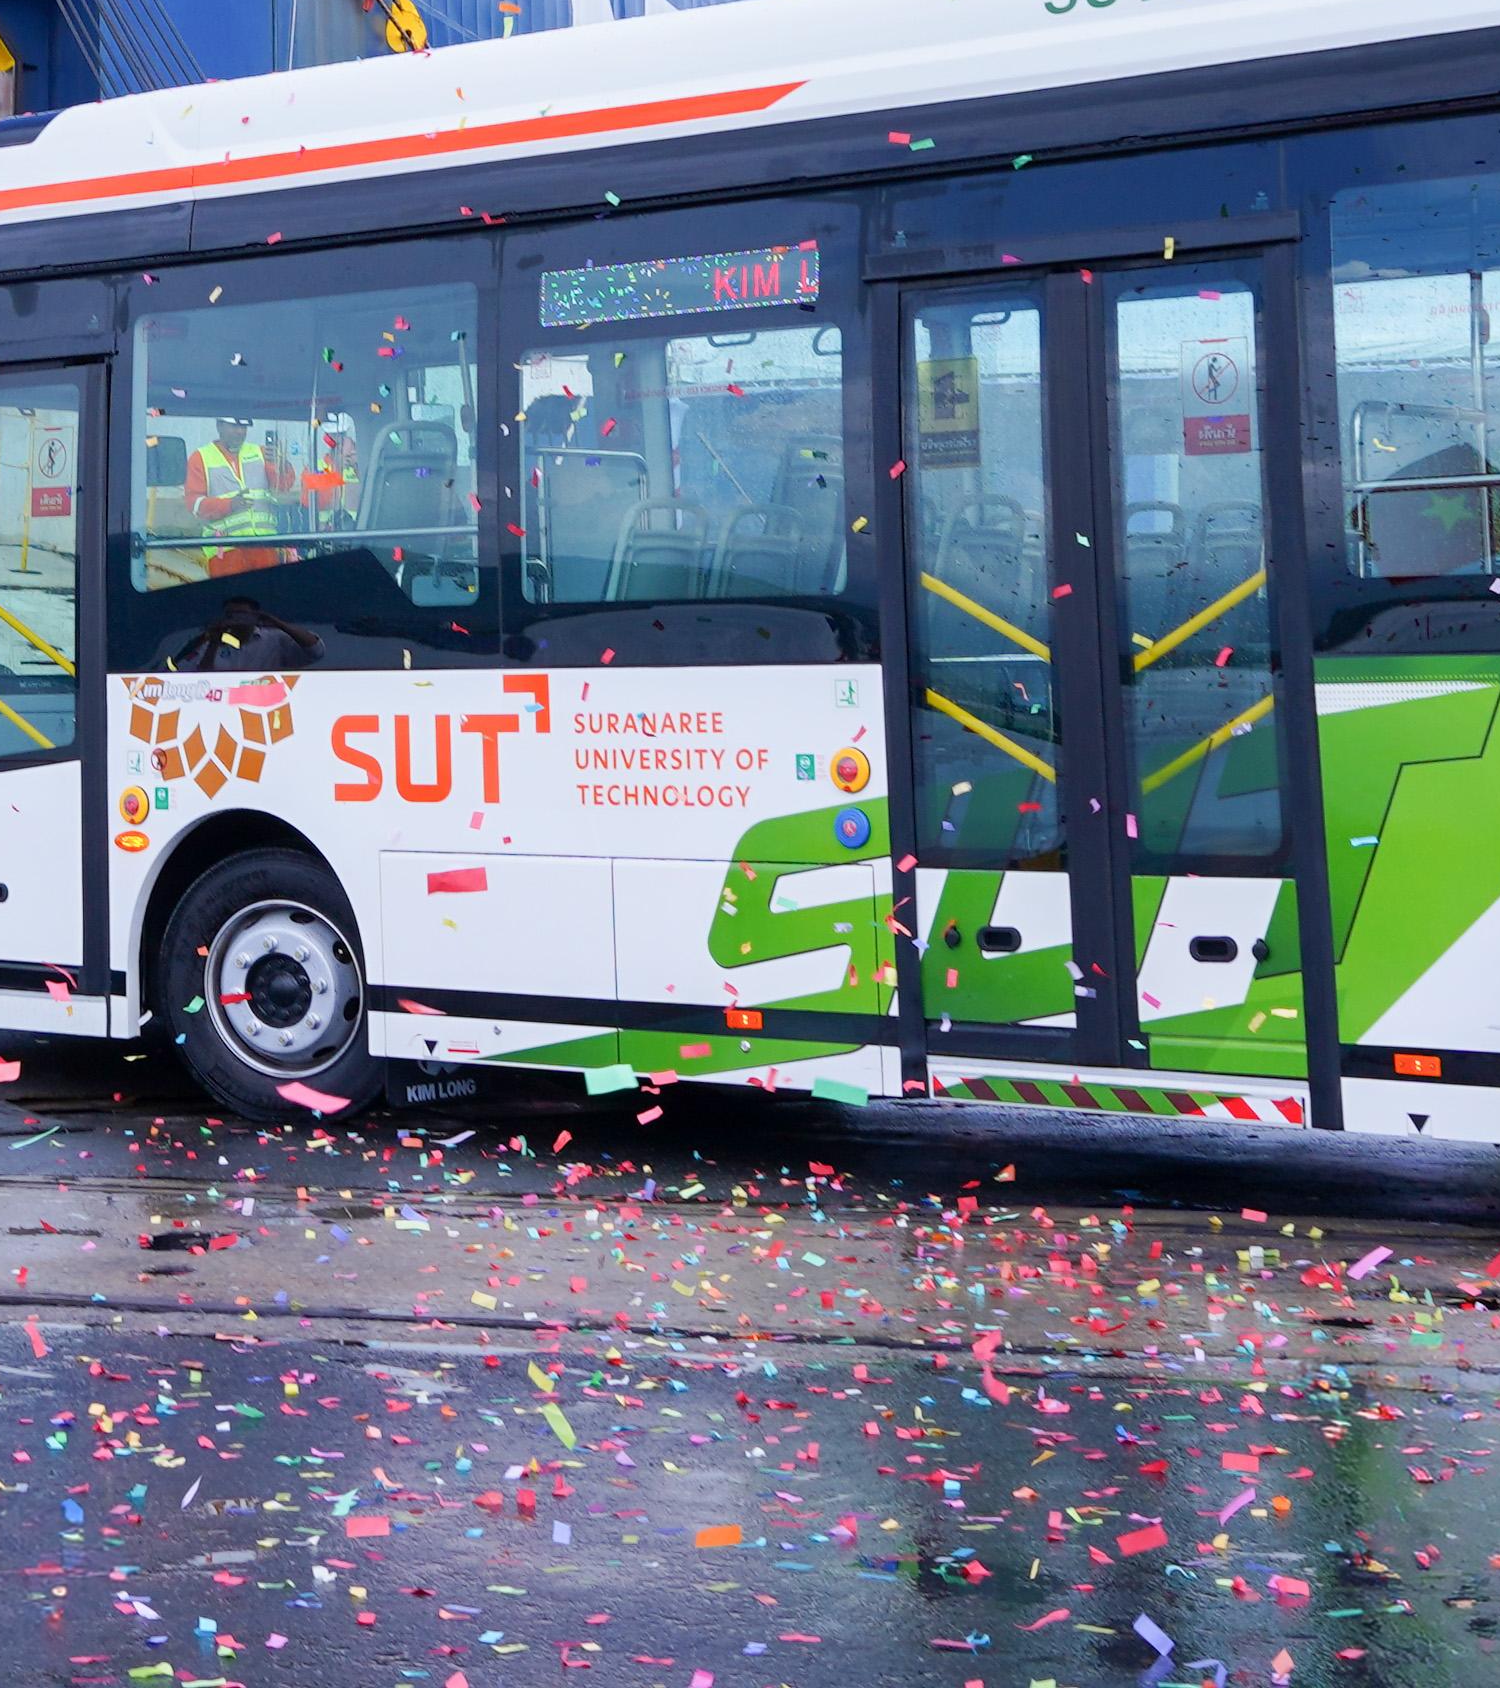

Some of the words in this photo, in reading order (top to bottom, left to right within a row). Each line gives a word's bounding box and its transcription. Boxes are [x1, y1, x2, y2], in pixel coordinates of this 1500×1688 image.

[713, 262, 782, 301] KIM
[573, 712, 724, 735] SURANAREE
[331, 714, 519, 804] SUT
[575, 749, 726, 770] UNIVERSITY
[736, 749, 769, 770] OF
[576, 785, 751, 807] TECHNOLOGY
[406, 1082, 437, 1103] KIM
[438, 1078, 477, 1099] LONG
